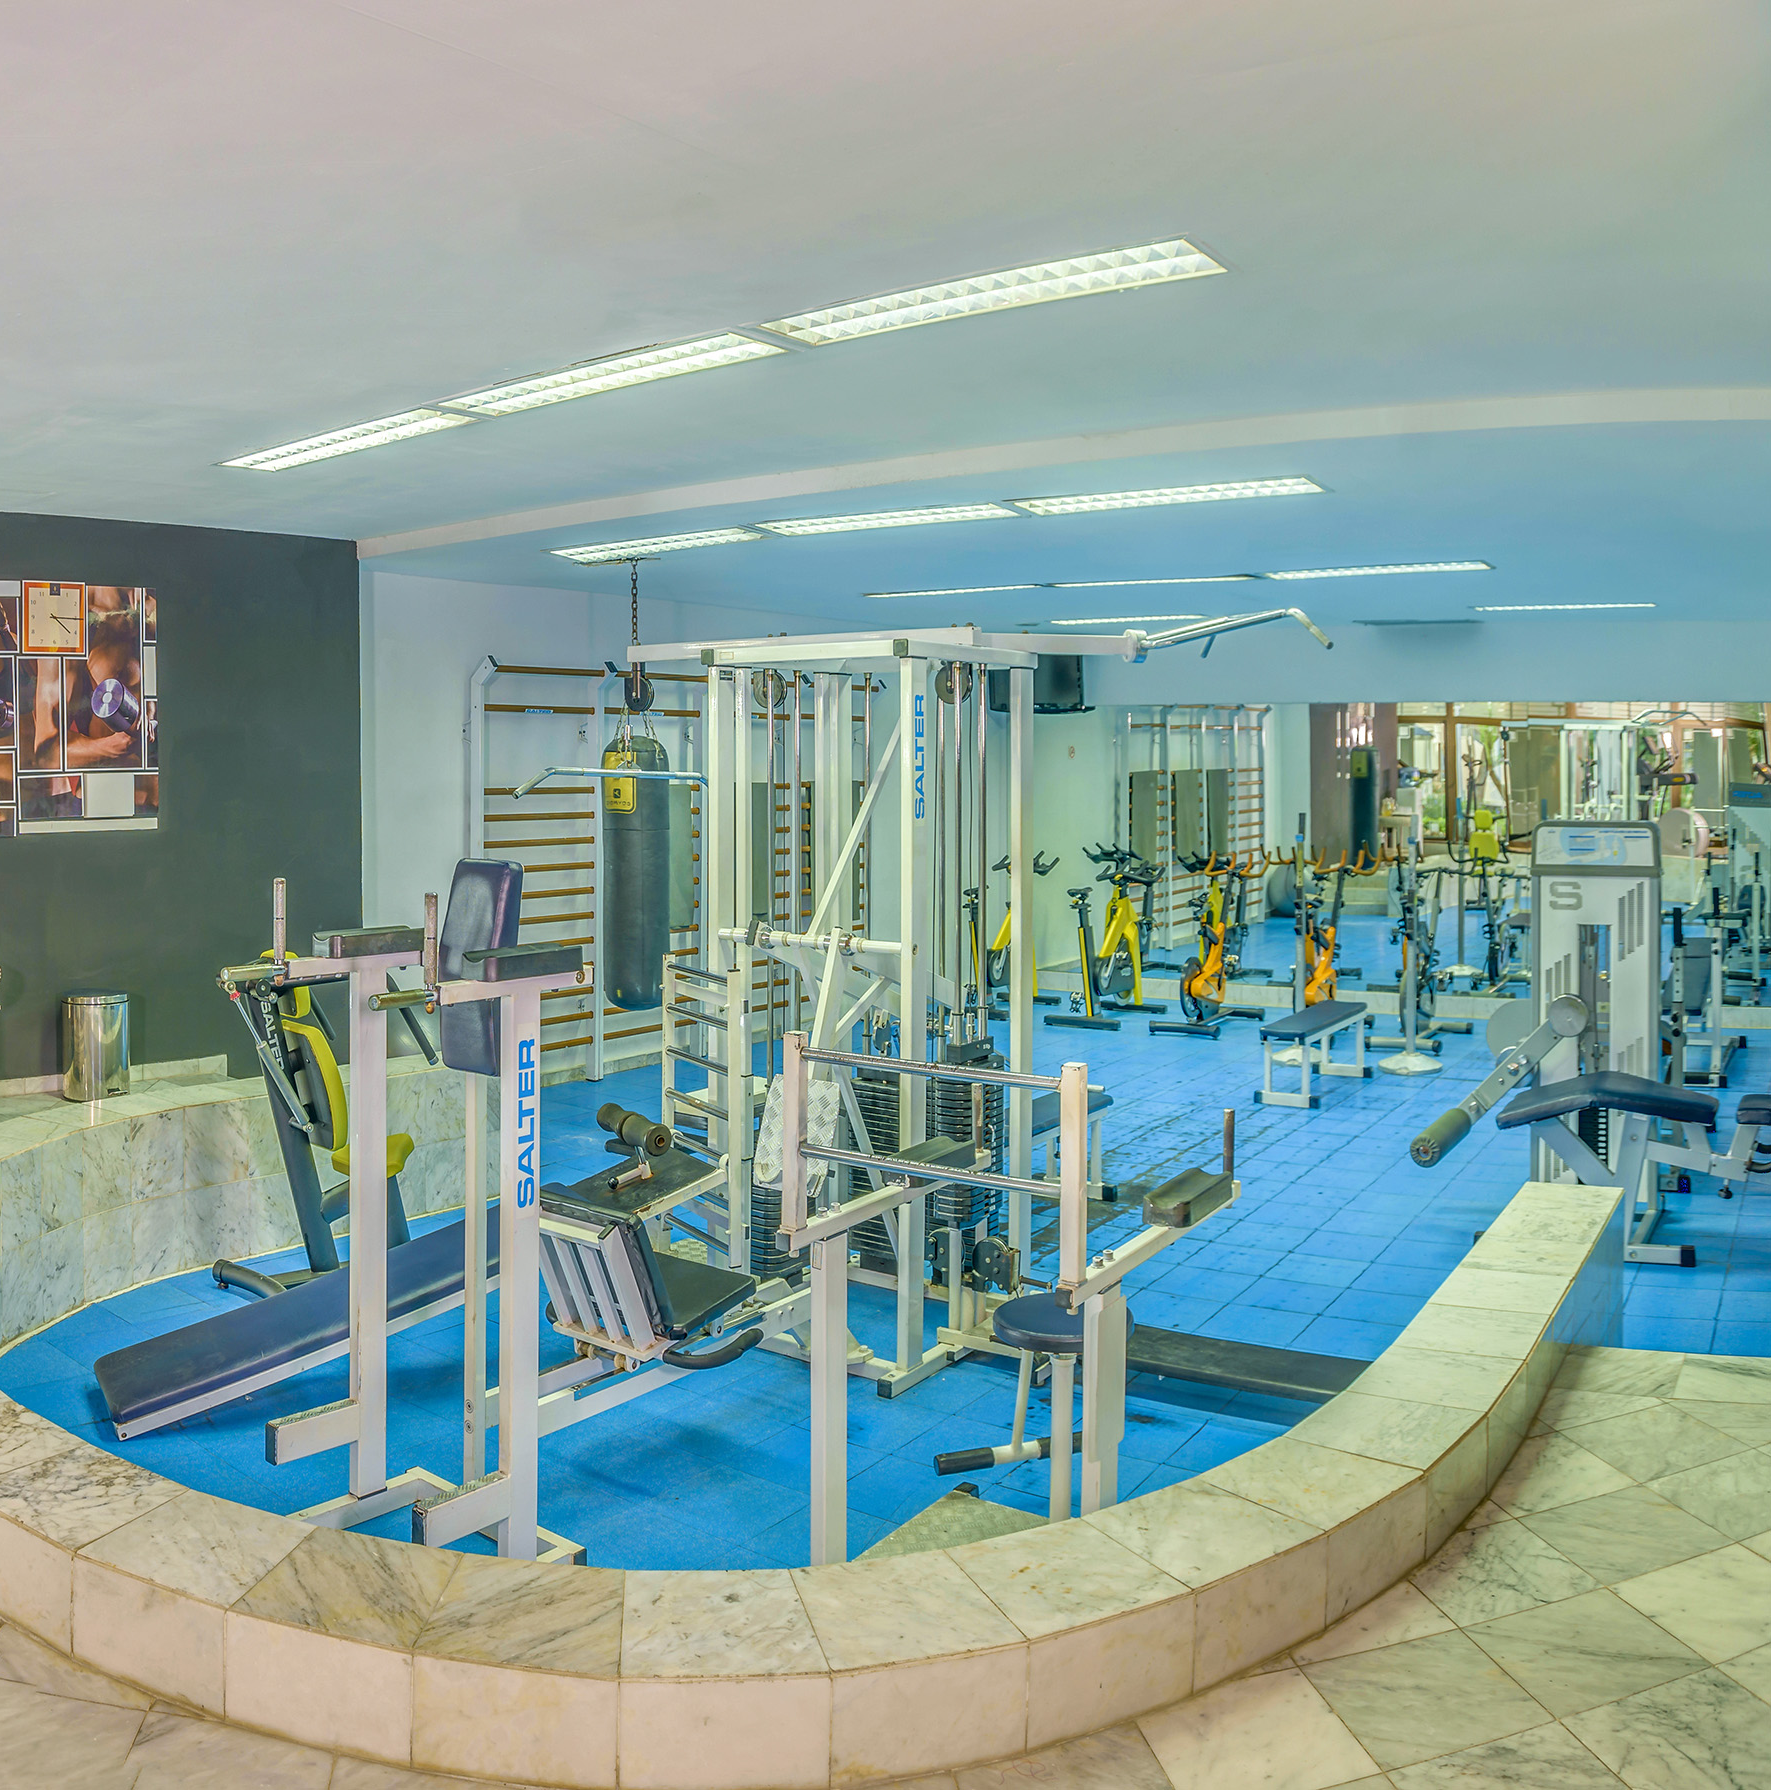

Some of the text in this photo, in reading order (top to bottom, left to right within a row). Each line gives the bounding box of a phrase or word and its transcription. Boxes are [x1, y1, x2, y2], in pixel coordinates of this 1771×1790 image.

[915, 694, 925, 819] SALTER
[1549, 881, 1583, 911] S
[517, 1038, 535, 1209] SALTER
